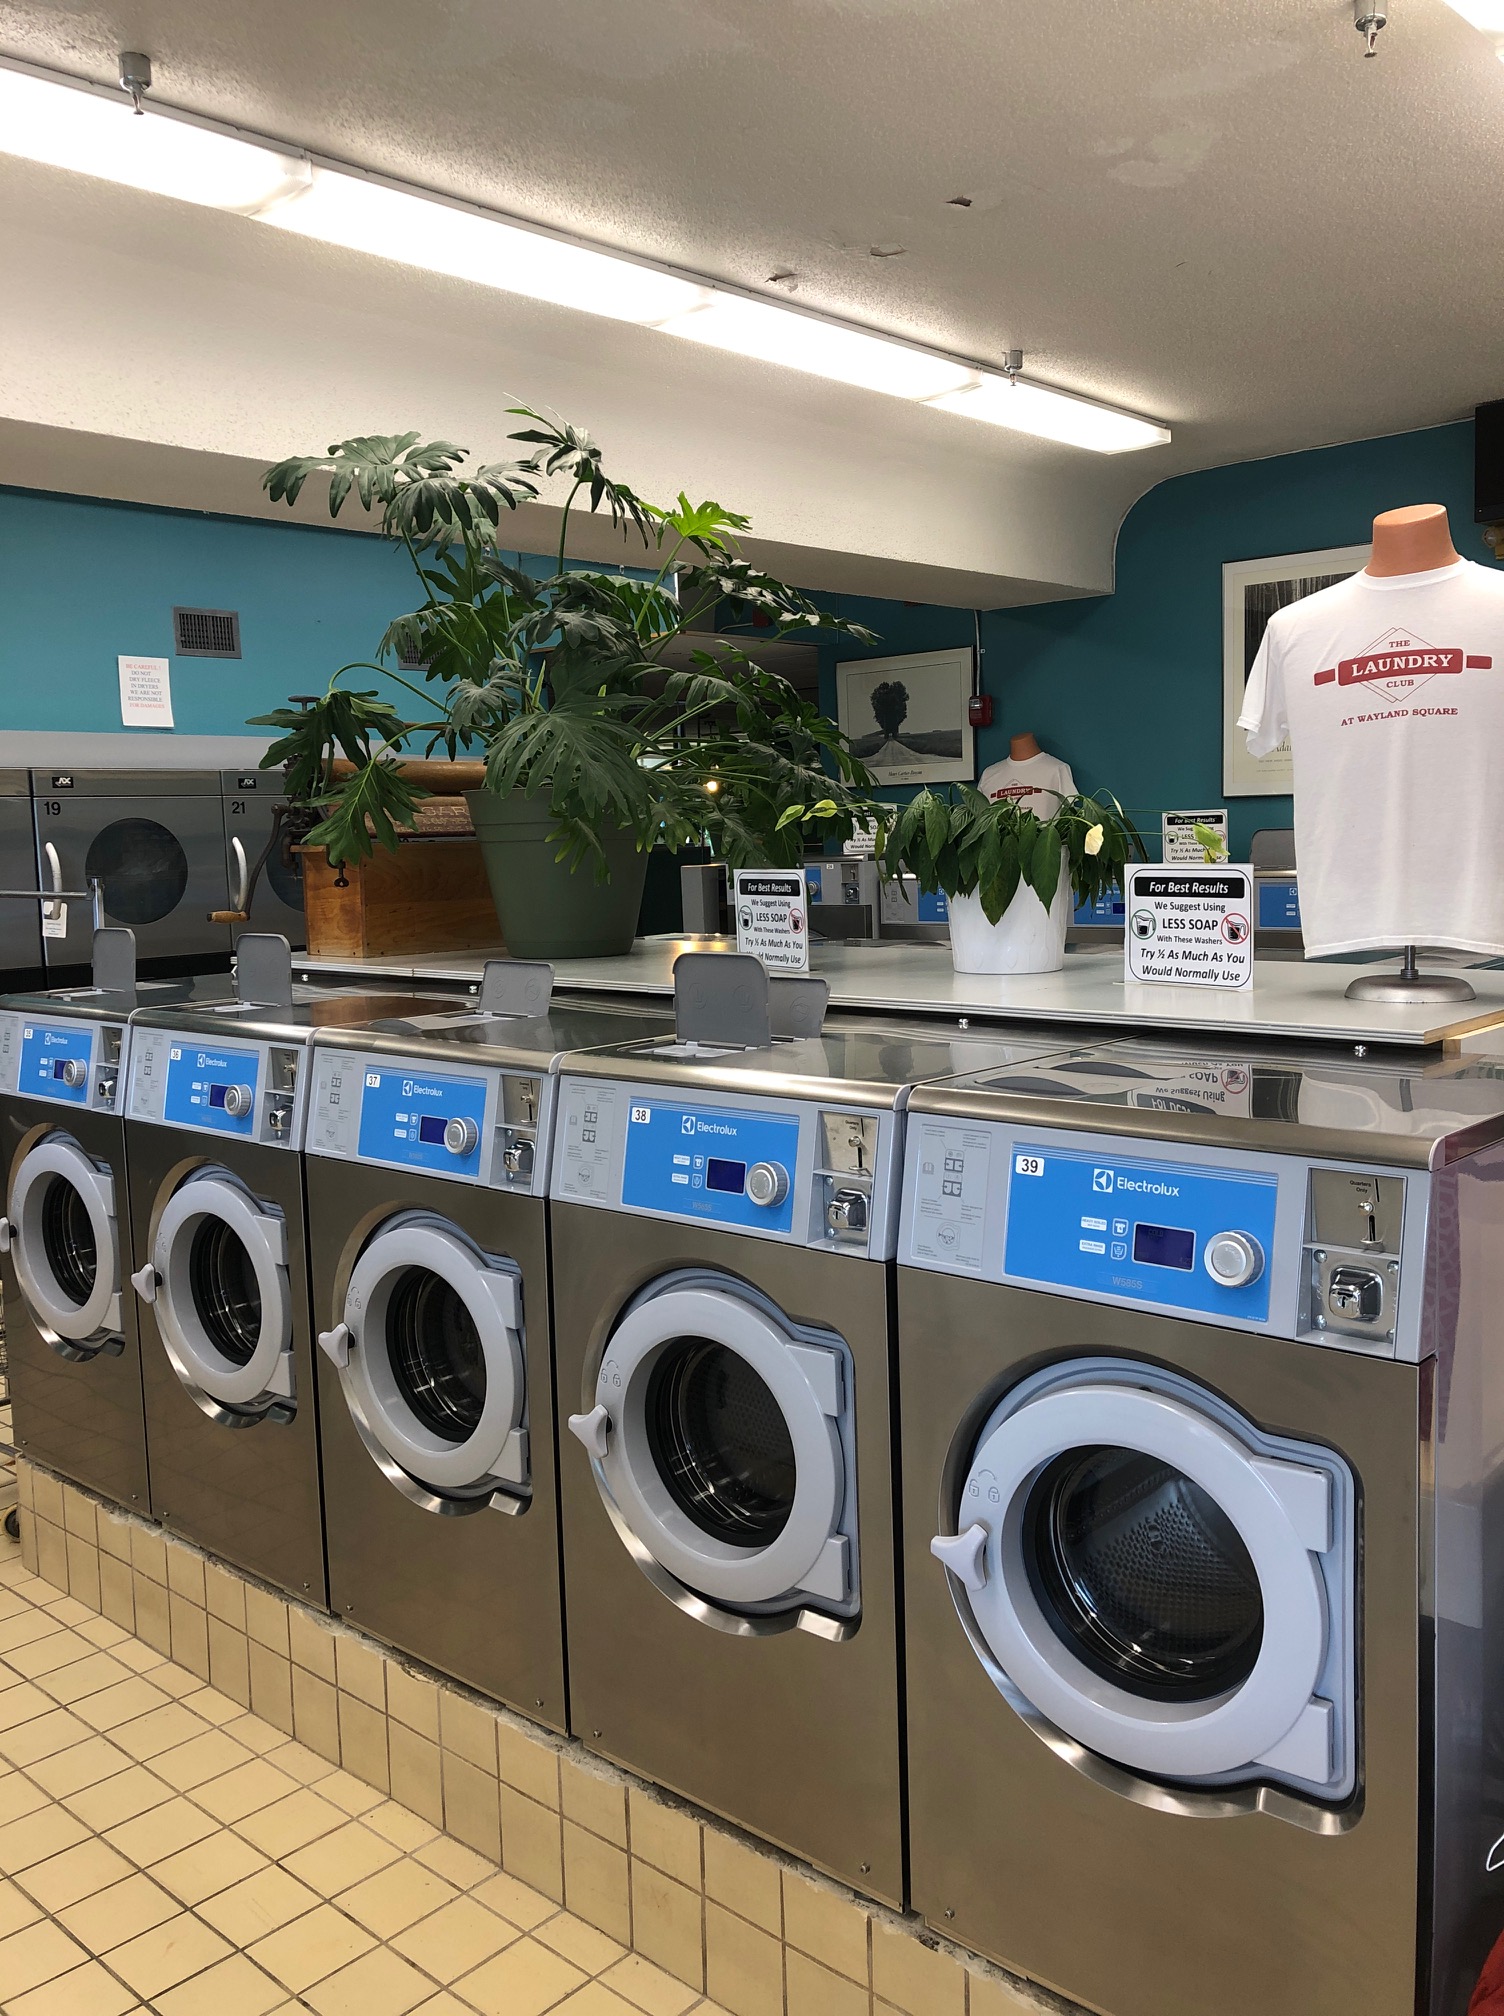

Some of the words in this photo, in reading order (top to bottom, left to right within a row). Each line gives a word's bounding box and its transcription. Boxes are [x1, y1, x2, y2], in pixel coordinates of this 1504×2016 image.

[1389, 640, 1410, 648] THE
[1351, 654, 1454, 677] LAUNDRY
[1386, 679, 1414, 688] CLUB
[1341, 718, 1355, 726] AT
[1357, 709, 1409, 723] WAYLAND
[1412, 708, 1458, 717] SQUARE
[44, 802, 61, 816] 19
[232, 801, 245, 814] 21
[747, 882, 757, 892] For
[758, 883, 770, 892] Best
[771, 883, 792, 893] Results
[1149, 882, 1166, 893] For
[1168, 882, 1190, 893] Best
[1192, 882, 1229, 894] Results
[760, 899, 777, 908] Suggest
[778, 900, 791, 908] Using
[1154, 901, 1168, 910] We
[1170, 902, 1201, 912] Suggest
[1203, 902, 1226, 913] Using
[756, 913, 770, 922] LESS
[771, 913, 787, 922] SOAP
[1162, 918, 1186, 930] LESS
[1189, 919, 1218, 930] SOAP
[745, 937, 754, 948] Try
[760, 938, 767, 947] As
[768, 939, 784, 948] Much
[784, 940, 791, 949] As
[793, 941, 803, 950] You
[1174, 935, 1193, 944] These
[1194, 937, 1223, 945] Washers
[765, 953, 790, 965] Normally
[790, 955, 801, 964] Use
[1140, 948, 1155, 960] Try
[1167, 949, 1179, 960] As
[1182, 950, 1209, 962] Much
[1211, 952, 1223, 962] As
[1226, 952, 1245, 964] You
[1142, 965, 1172, 976] Would
[1175, 967, 1220, 982] Normally
[1222, 970, 1241, 981] Use
[172, 1050, 179, 1059] 36
[206, 1058, 227, 1068] Electrolux
[369, 1076, 378, 1086] 37
[413, 1084, 443, 1097] Electrolux
[635, 1109, 647, 1122] 38
[697, 1121, 738, 1136] Electrolux
[1021, 1158, 1039, 1174] 39
[1117, 1176, 1180, 1198] Electrolux
